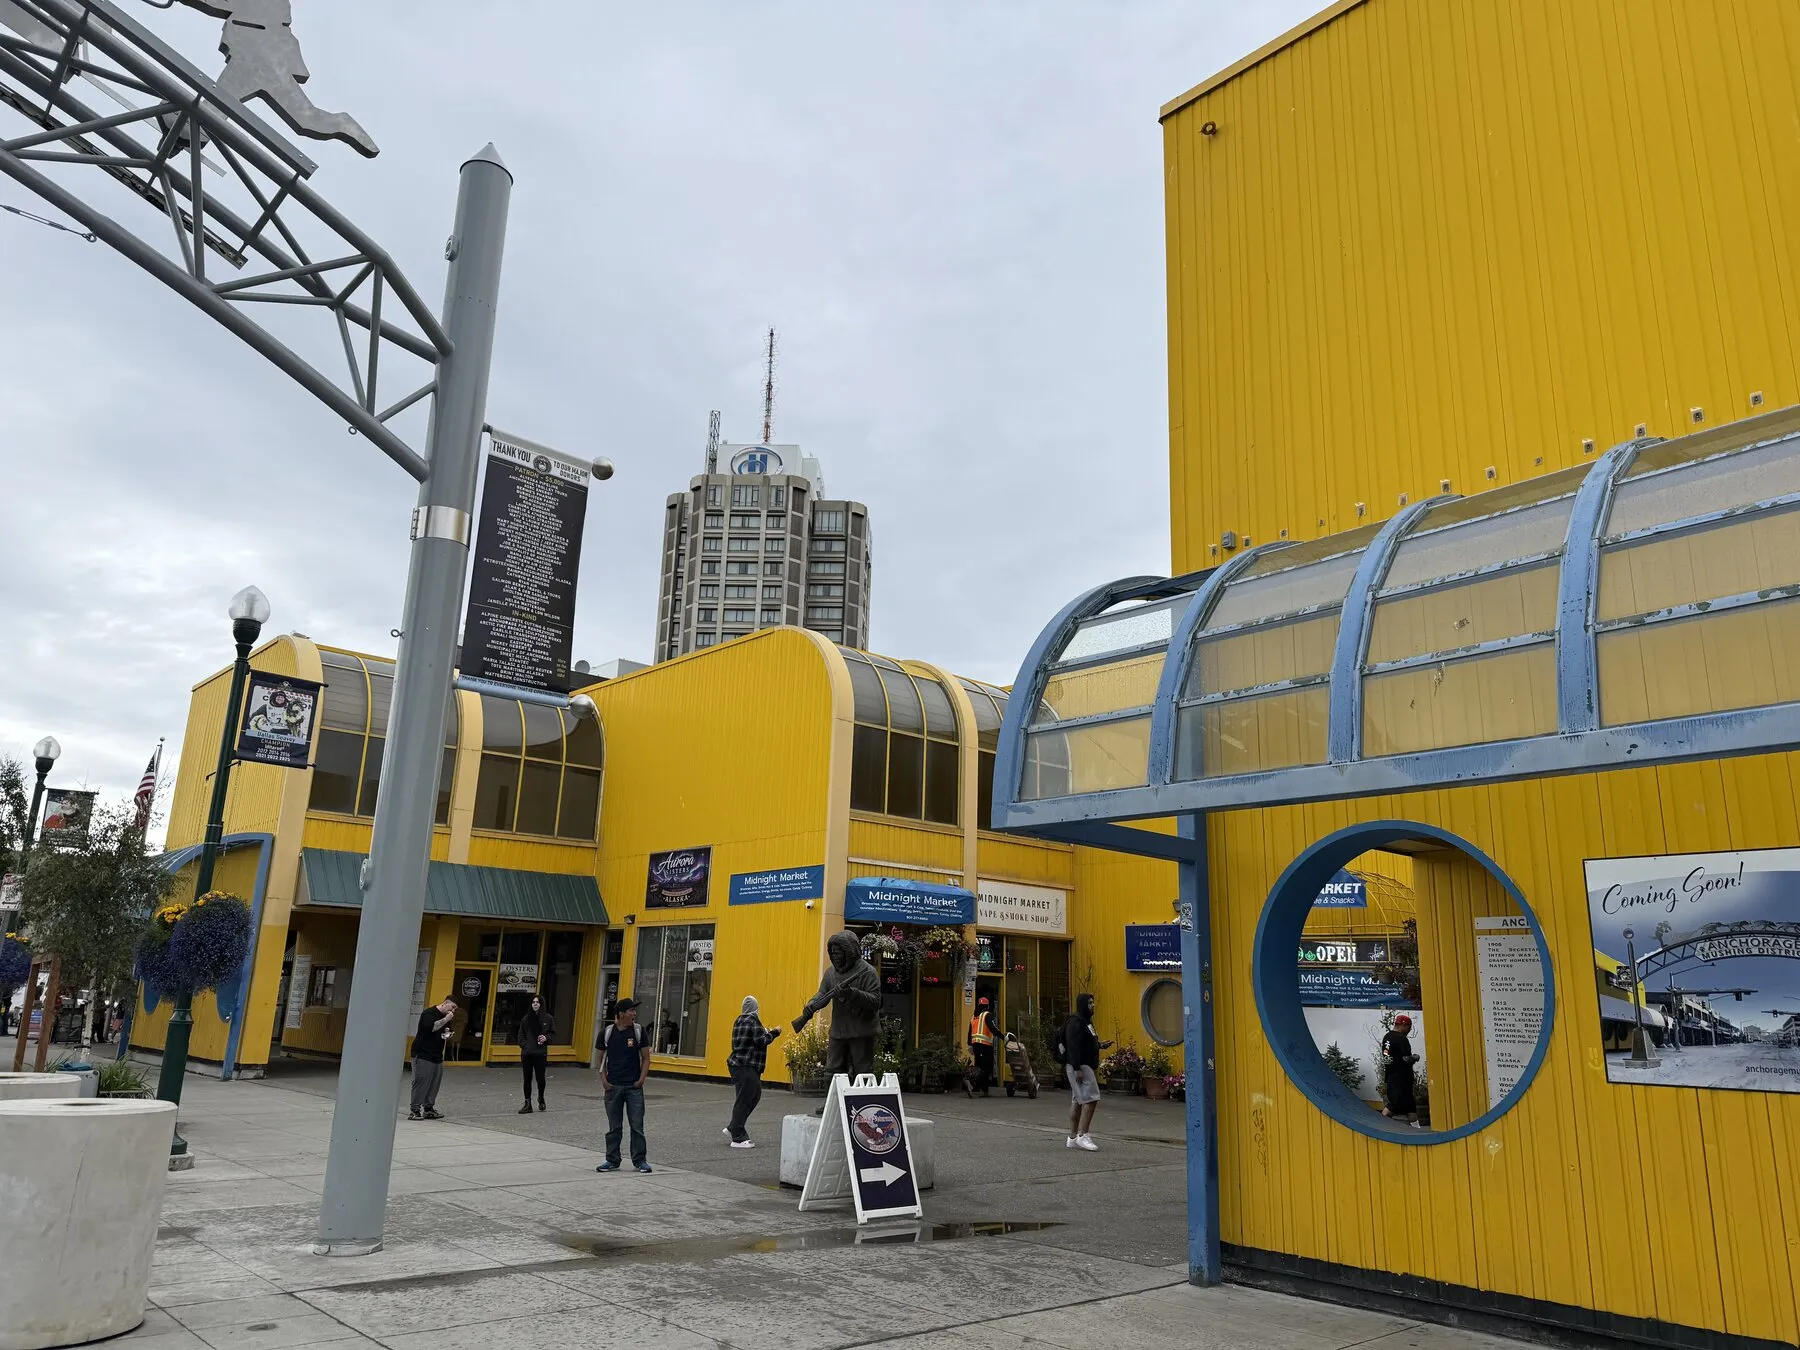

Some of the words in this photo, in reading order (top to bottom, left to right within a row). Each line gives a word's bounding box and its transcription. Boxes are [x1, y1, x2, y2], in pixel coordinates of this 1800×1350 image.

[492, 440, 517, 458] THANK
[518, 449, 531, 462] YOU
[560, 463, 571, 472] OUR
[511, 609, 536, 621] IN-KIND
[261, 739, 290, 747] CHAMPION
[656, 852, 694, 874] Aurora
[744, 874, 777, 885] Midnight
[780, 871, 808, 881] Market
[1602, 883, 1679, 914] Coming
[1682, 861, 1744, 903] Soon!
[868, 891, 920, 904] Midnight
[924, 896, 957, 907] Market
[978, 894, 1017, 906] MIDNIGHT
[1020, 899, 1050, 910] MARKET
[980, 909, 997, 918] VAPE
[1031, 915, 1049, 923] SHOP
[1708, 937, 1800, 950] ANCHORAGE
[1316, 946, 1356, 962] OPEN
[1702, 948, 1753, 960] MUSHING
[1301, 974, 1355, 986] Midnight
